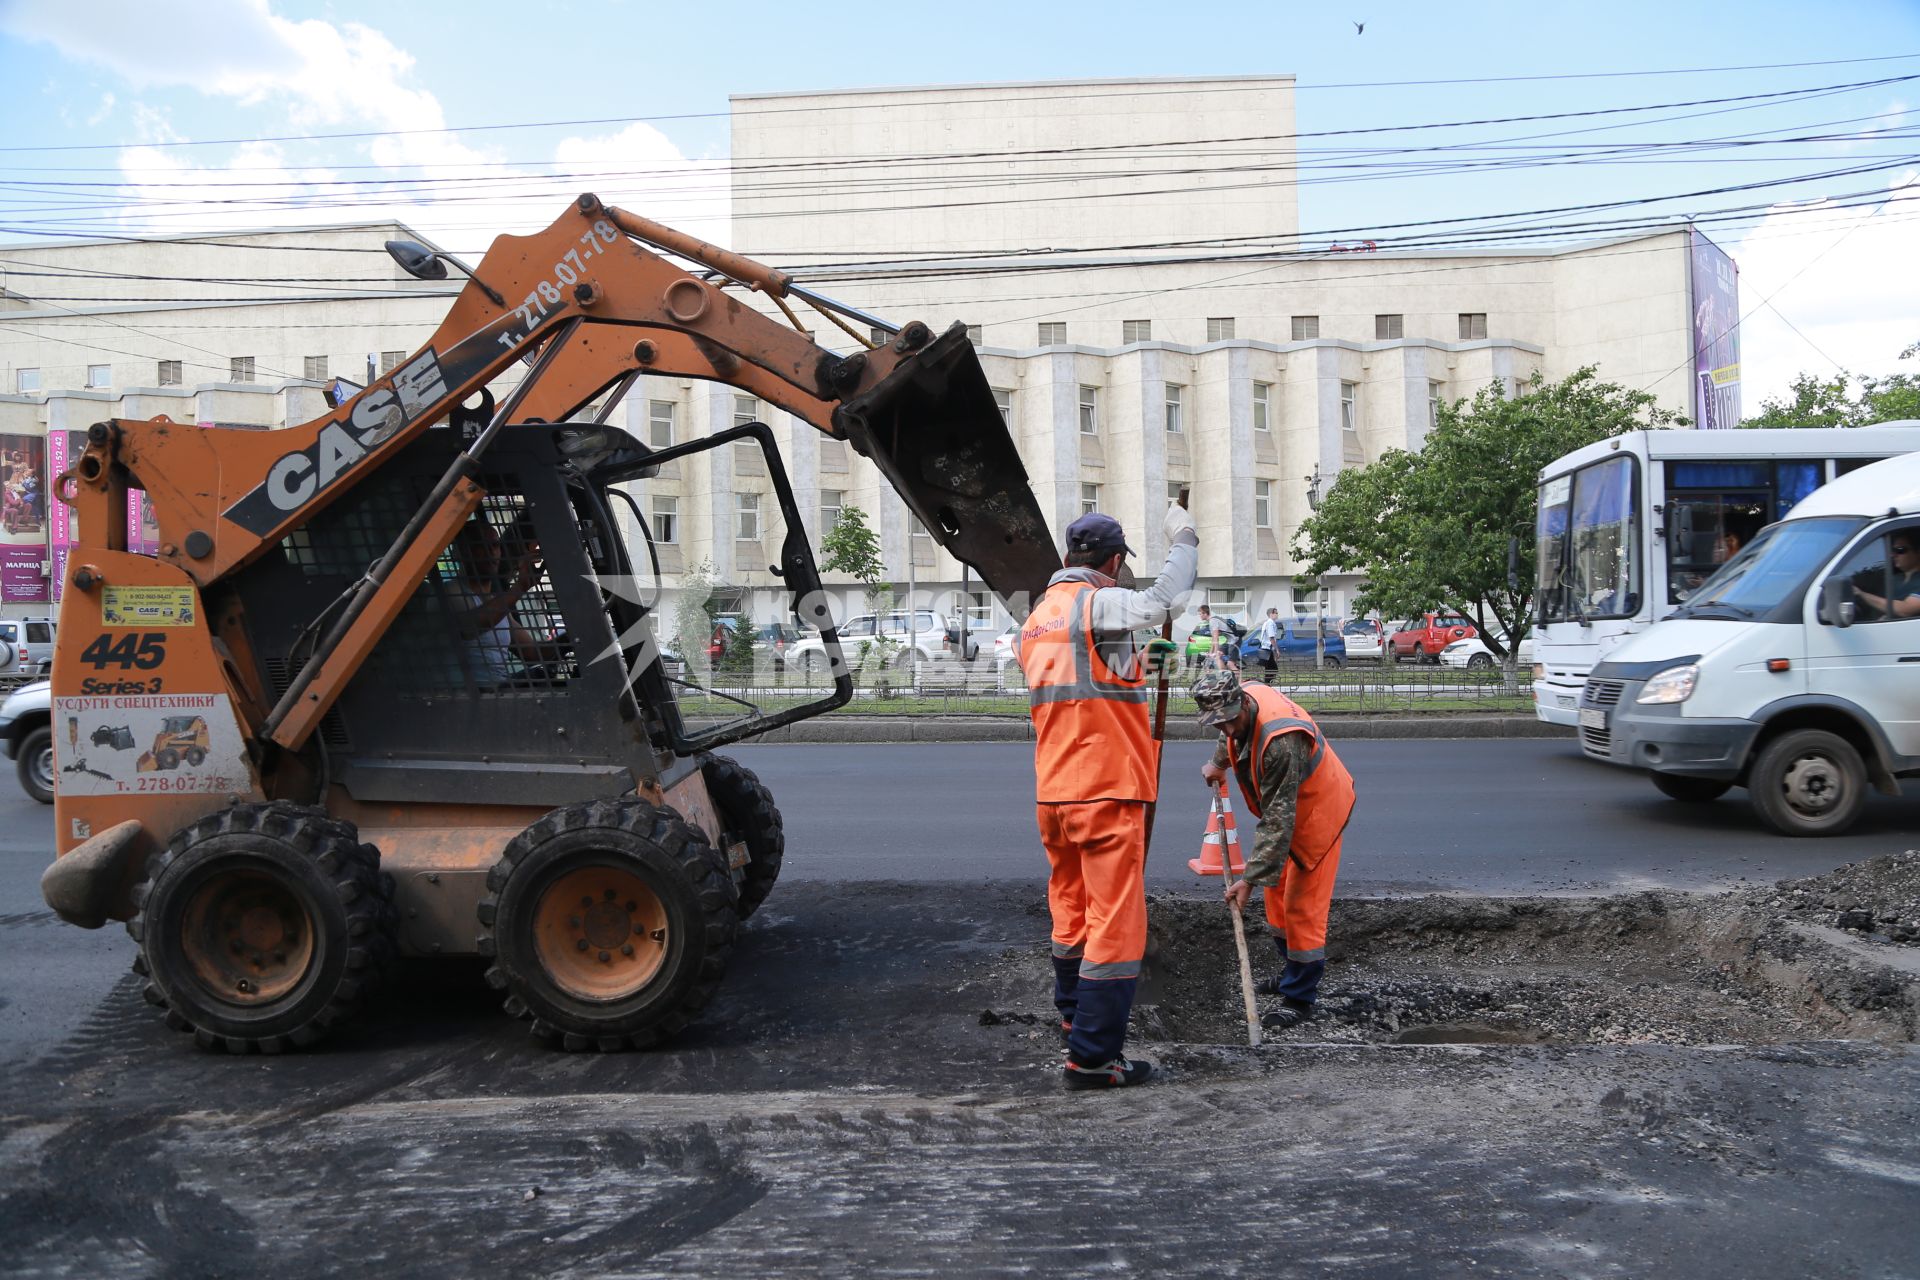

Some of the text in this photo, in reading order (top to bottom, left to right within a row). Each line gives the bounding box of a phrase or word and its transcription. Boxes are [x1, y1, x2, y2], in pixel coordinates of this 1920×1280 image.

[514, 220, 618, 331] 278-07-78
[267, 347, 449, 511] CASE
[80, 633, 167, 670] 445
[81, 677, 163, 695] Series 3
[56, 695, 215, 712] УСЛУГИ СПЕЦТЕХНИКИ
[136, 776, 226, 791] 278-07-78
